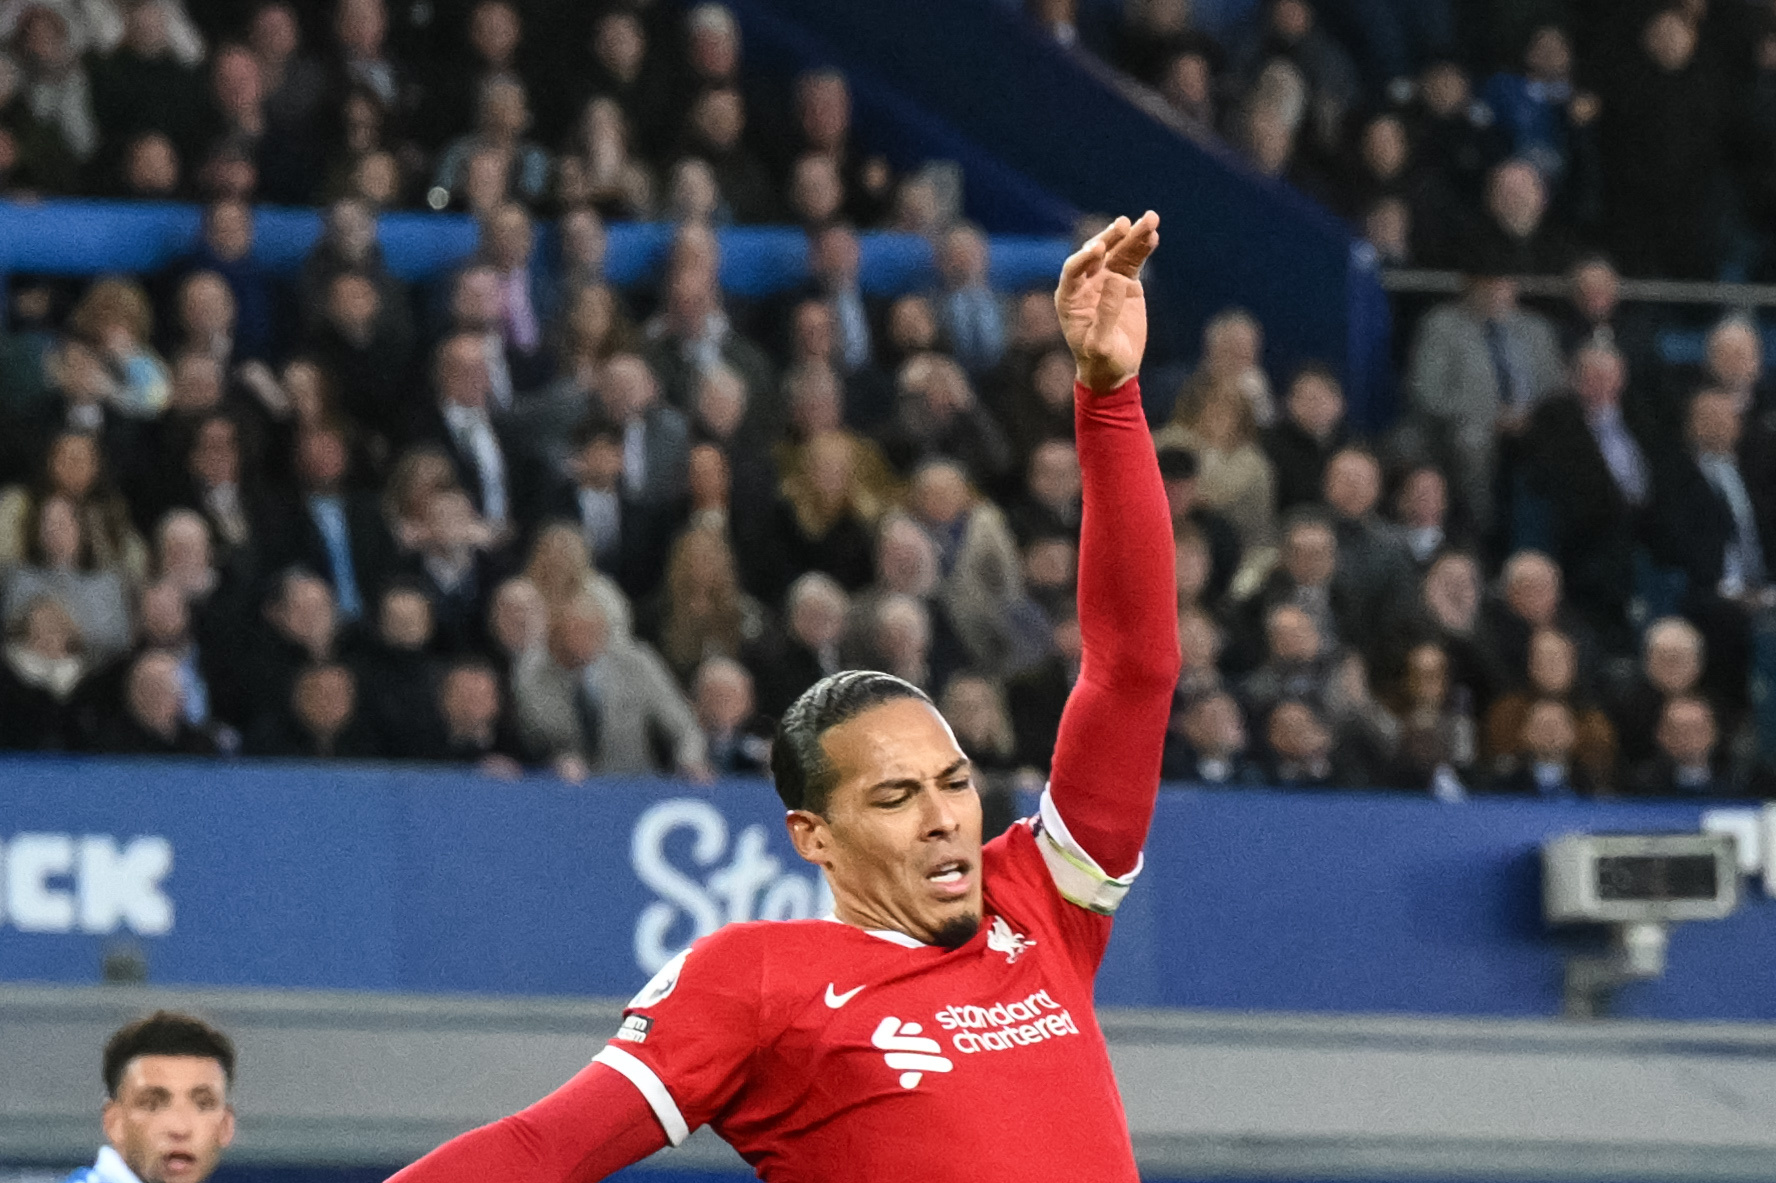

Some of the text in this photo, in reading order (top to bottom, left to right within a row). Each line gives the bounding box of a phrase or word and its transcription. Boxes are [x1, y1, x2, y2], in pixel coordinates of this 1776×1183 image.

[0, 830, 175, 935] CK
[935, 988, 1061, 1030] standard
[952, 1008, 1080, 1053] chartered
